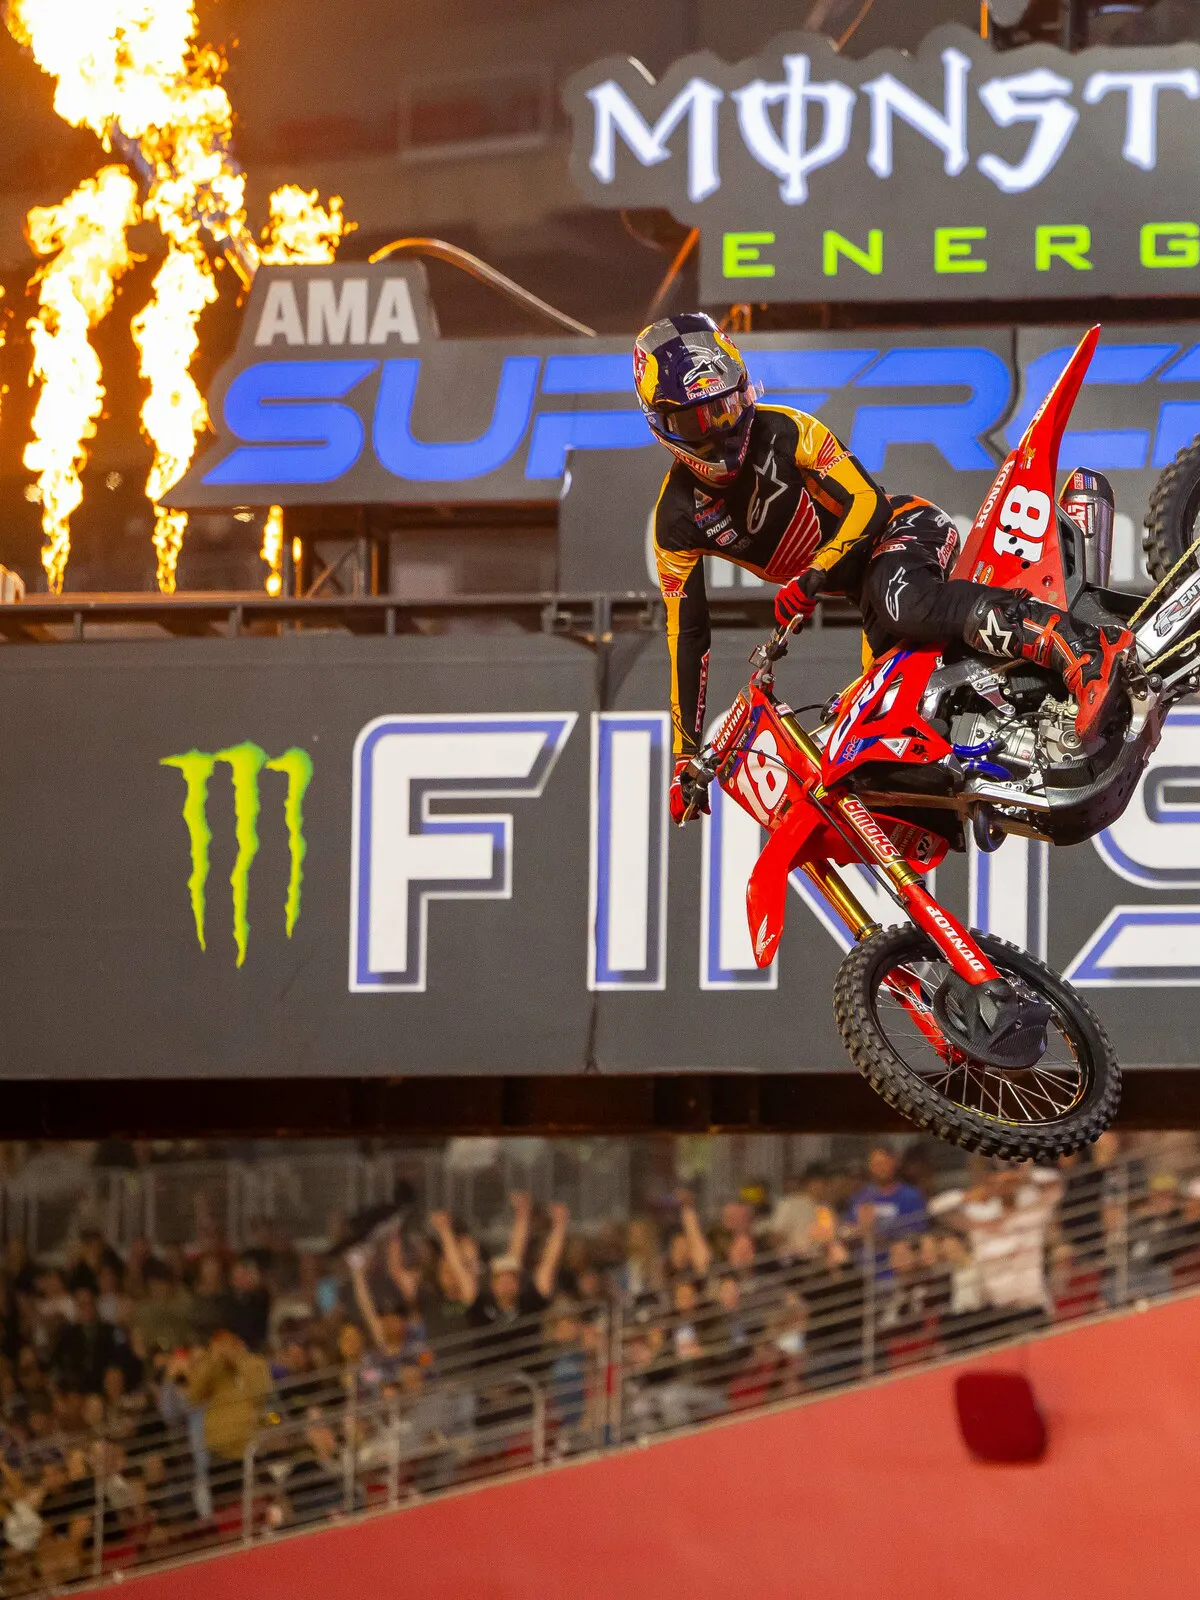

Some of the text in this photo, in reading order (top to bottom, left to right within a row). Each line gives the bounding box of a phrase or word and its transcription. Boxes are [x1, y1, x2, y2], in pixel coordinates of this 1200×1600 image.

[254, 279, 421, 347] AMA
[819, 451, 854, 479] HONDA
[975, 460, 1015, 529] HONDA
[706, 515, 732, 537] SHOWA
[993, 485, 1050, 563] 18
[716, 700, 747, 752] RENTHAL
[736, 729, 789, 826] 18
[773, 793, 788, 816] HONDA
[842, 799, 901, 858] SHOWA
[926, 905, 987, 972] DUNLOP
